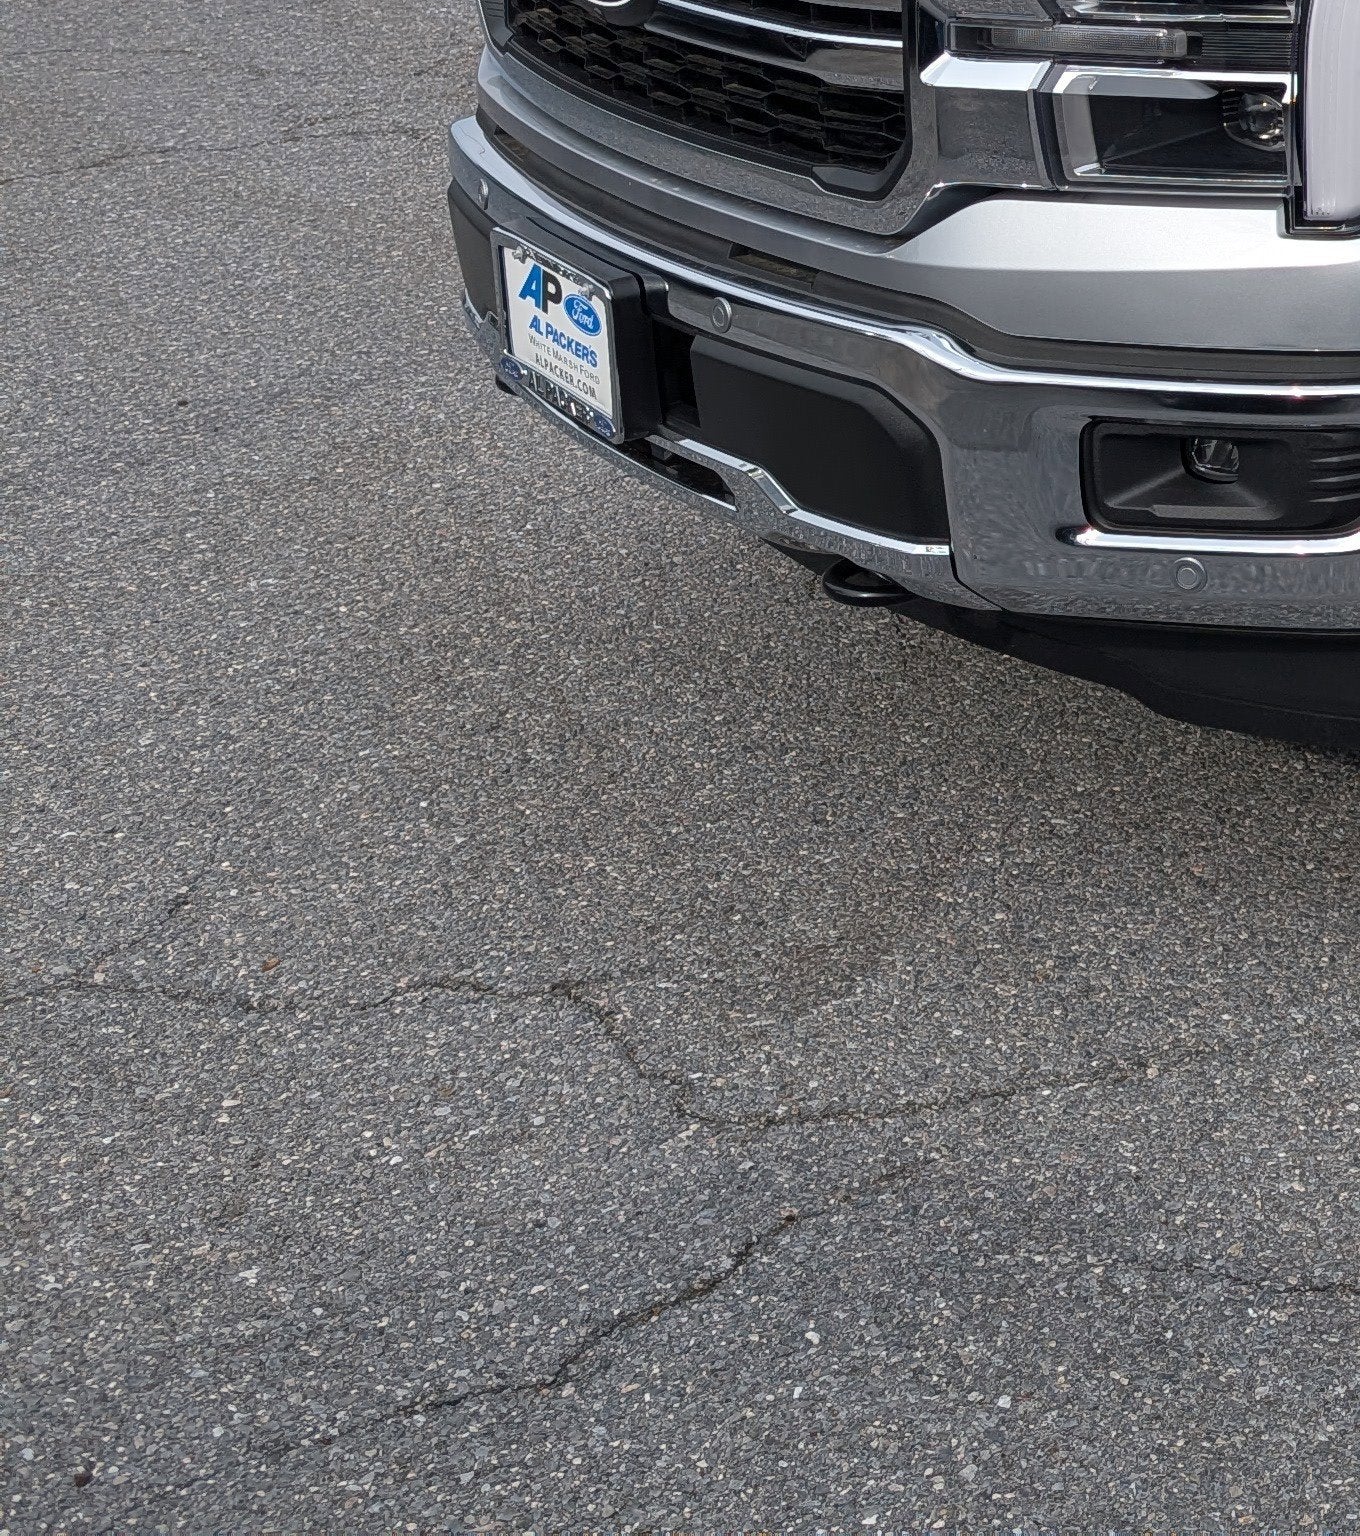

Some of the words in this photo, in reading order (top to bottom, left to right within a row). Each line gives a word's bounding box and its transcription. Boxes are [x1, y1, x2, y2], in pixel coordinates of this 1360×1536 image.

[518, 263, 563, 315] AP
[528, 315, 544, 337] AL
[572, 300, 596, 330] Ford
